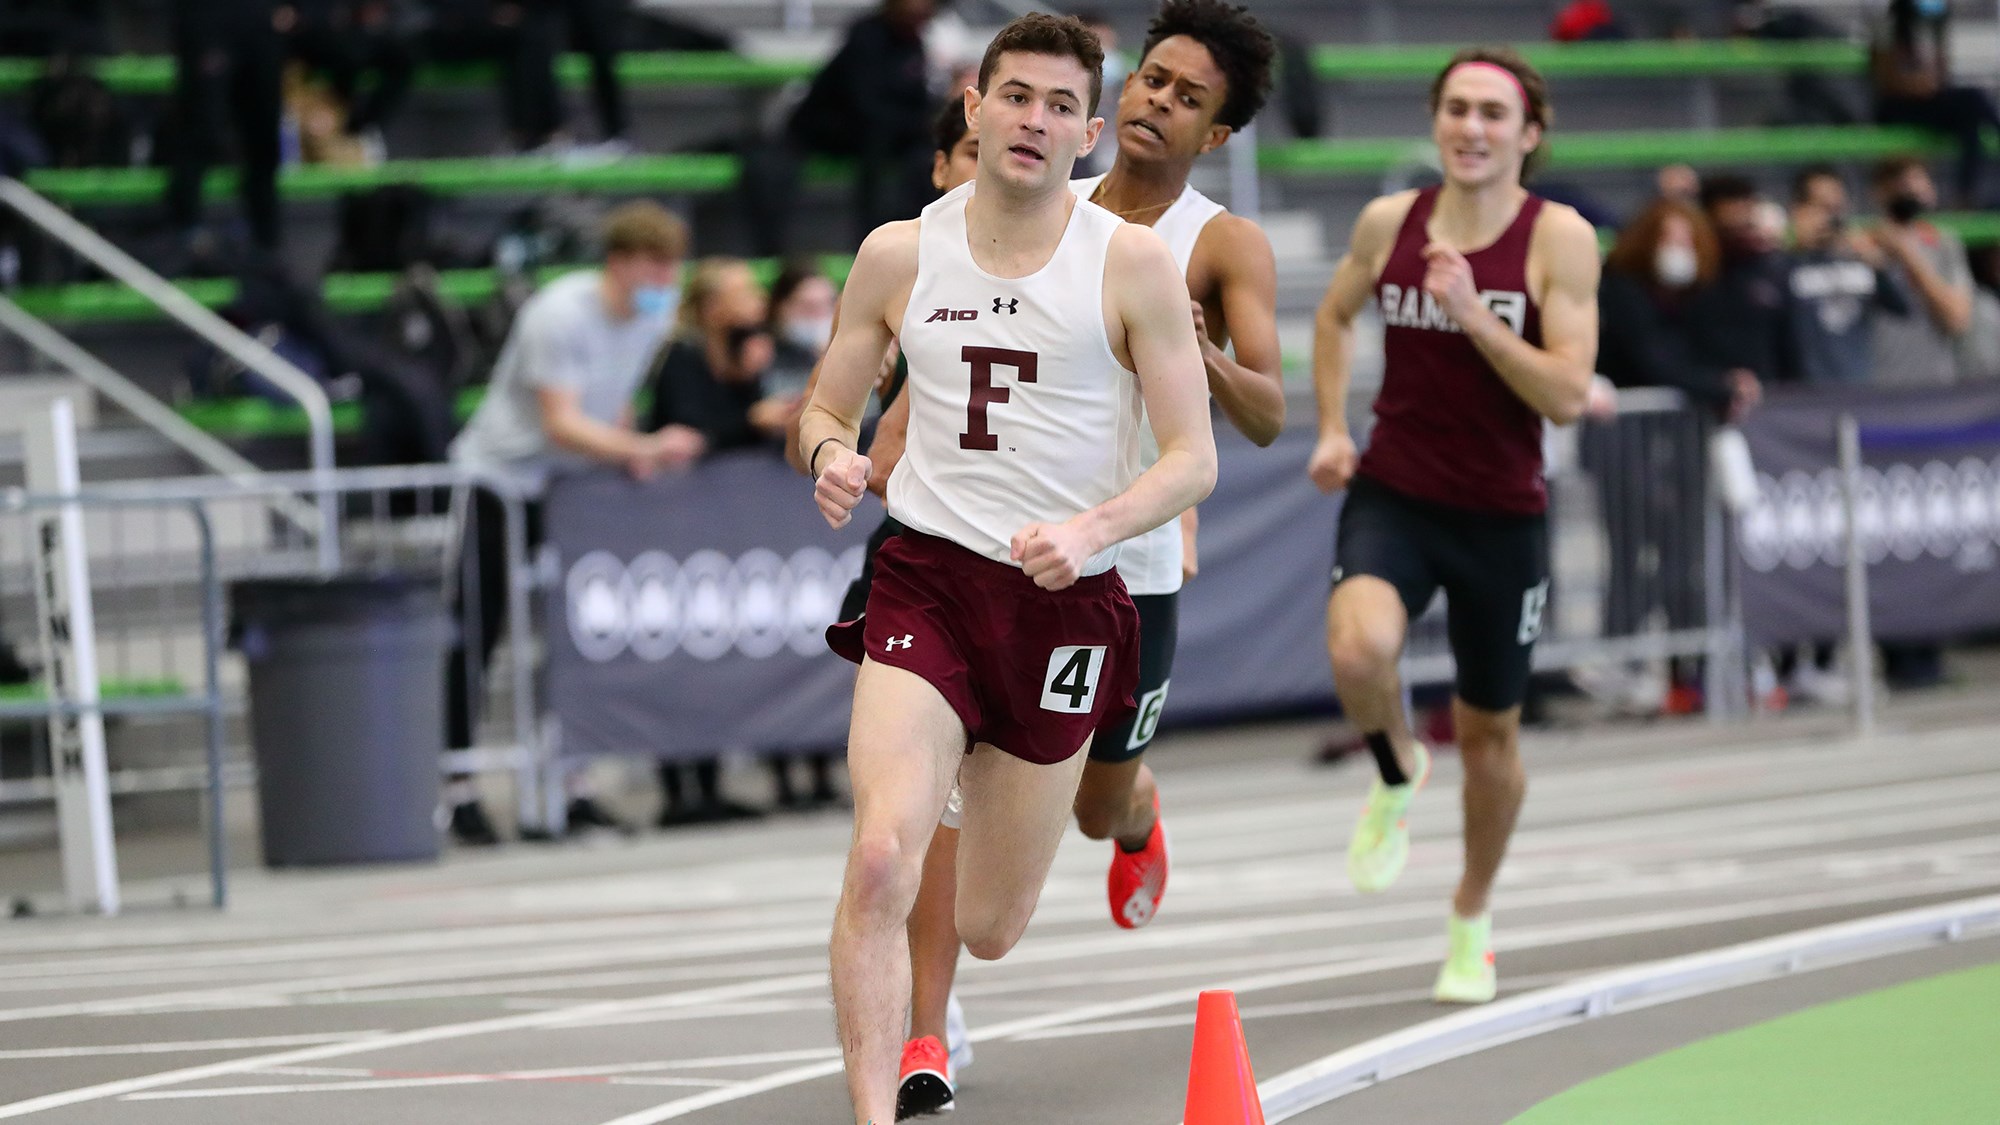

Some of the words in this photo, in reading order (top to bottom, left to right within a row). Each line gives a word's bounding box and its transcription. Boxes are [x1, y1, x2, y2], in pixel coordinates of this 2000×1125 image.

[924, 308, 979, 323] A10
[1382, 283, 1461, 333] RAM
[959, 345, 1038, 451] F
[1050, 648, 1093, 708] 4
[1136, 692, 1163, 742] 6
